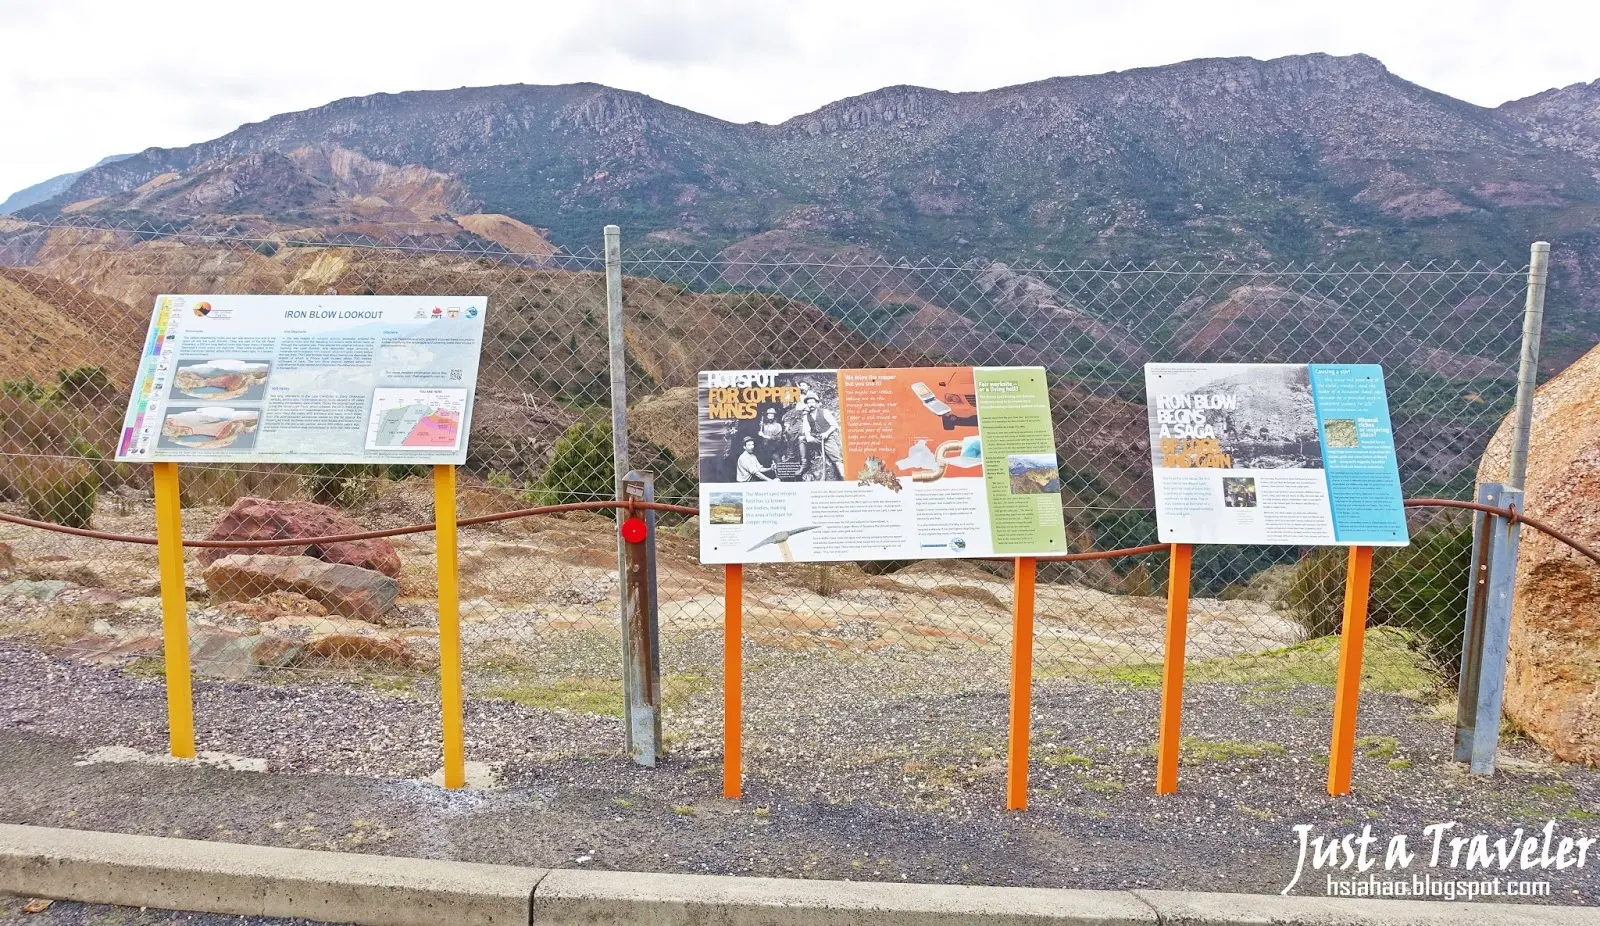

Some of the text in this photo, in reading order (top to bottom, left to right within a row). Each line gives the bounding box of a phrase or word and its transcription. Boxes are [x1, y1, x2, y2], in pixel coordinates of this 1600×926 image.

[284, 310, 384, 319] IRON BLOW LOOKOUT
[708, 372, 779, 388] HOTSPOT
[709, 387, 801, 403] FOR COPPER
[1156, 394, 1237, 409] IRON BLOW
[709, 403, 758, 419] MINES
[1157, 409, 1207, 424] BEGINS
[1160, 424, 1217, 439] A SAGA
[1196, 453, 1234, 468] GAIN
